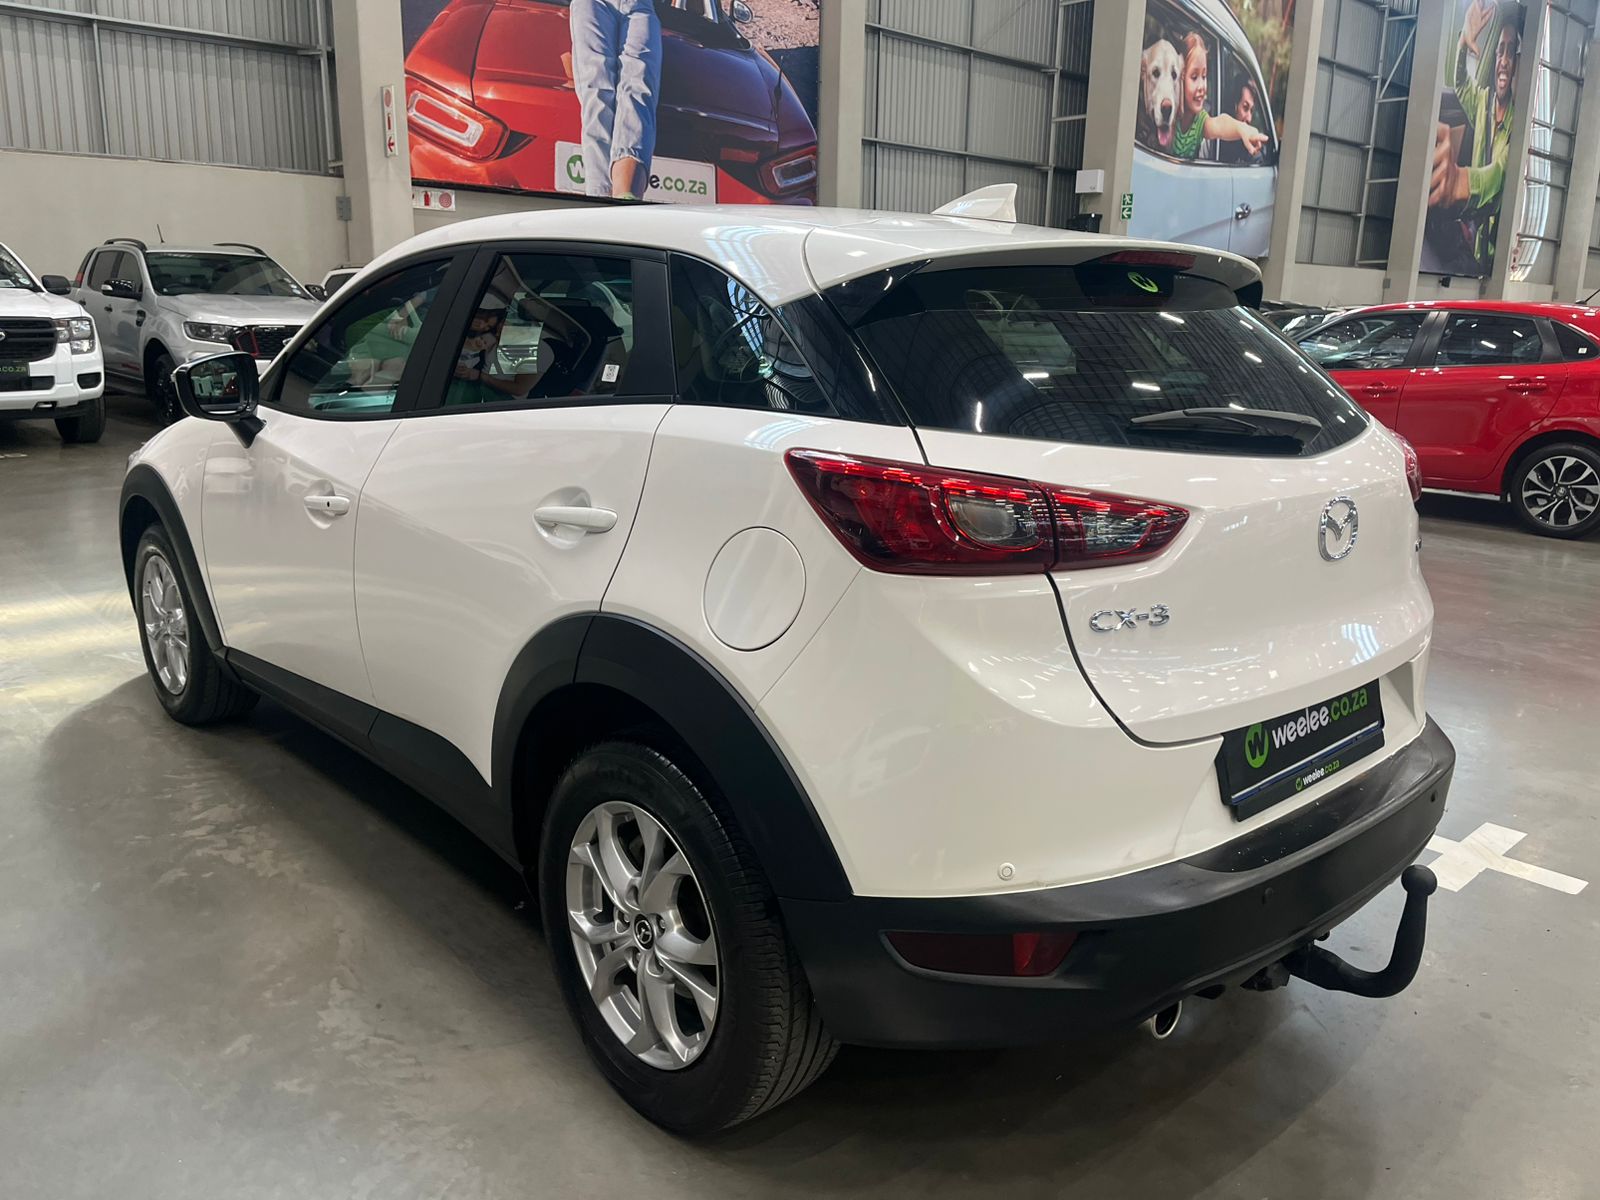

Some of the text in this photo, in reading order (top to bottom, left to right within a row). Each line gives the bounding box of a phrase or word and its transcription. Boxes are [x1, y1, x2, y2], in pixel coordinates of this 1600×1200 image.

[649, 174, 708, 195] e.co.za
[1089, 604, 1169, 632] CX-3
[1272, 688, 1368, 748] weelee.co.za
[1303, 760, 1340, 786] weelee.co.za
